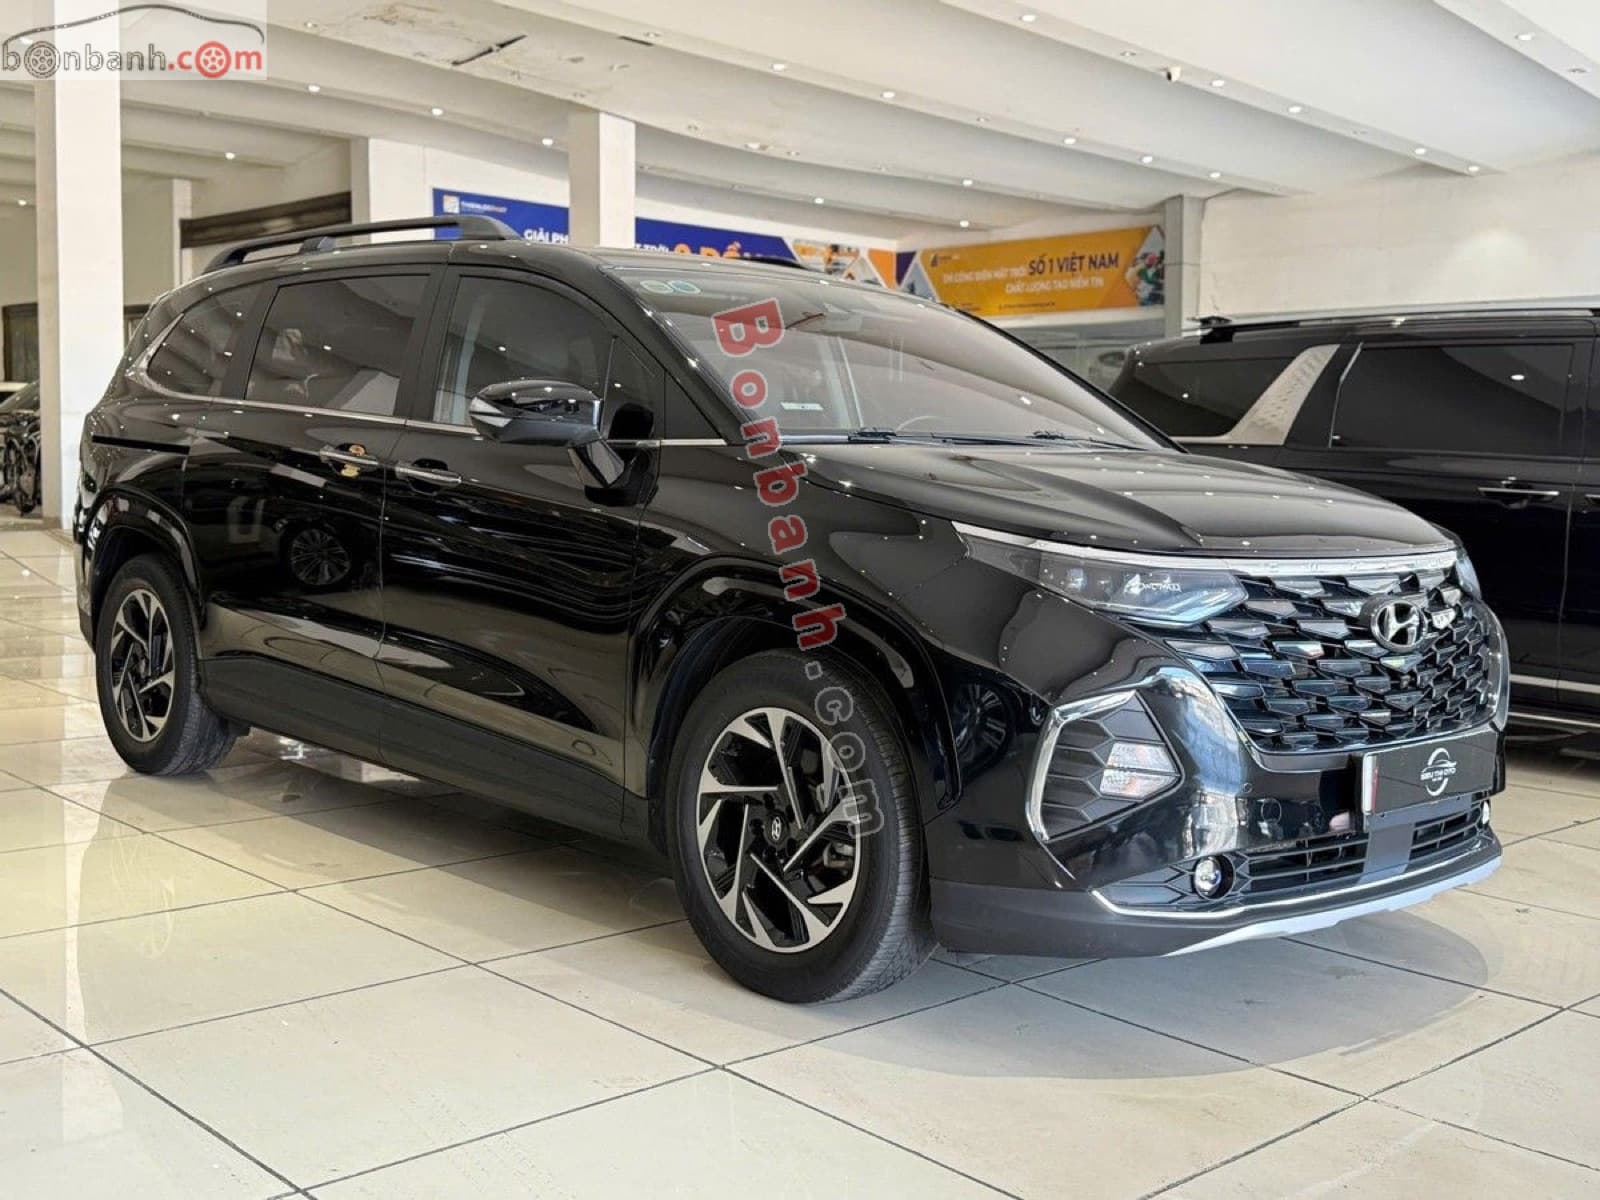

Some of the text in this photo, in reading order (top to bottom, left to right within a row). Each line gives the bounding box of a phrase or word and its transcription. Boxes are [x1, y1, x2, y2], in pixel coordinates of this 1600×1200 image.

[1028, 253, 1046, 275] SỐ
[1048, 258, 1054, 273] 1
[1056, 251, 1084, 276] VIỆT
[1088, 252, 1118, 271] NAM
